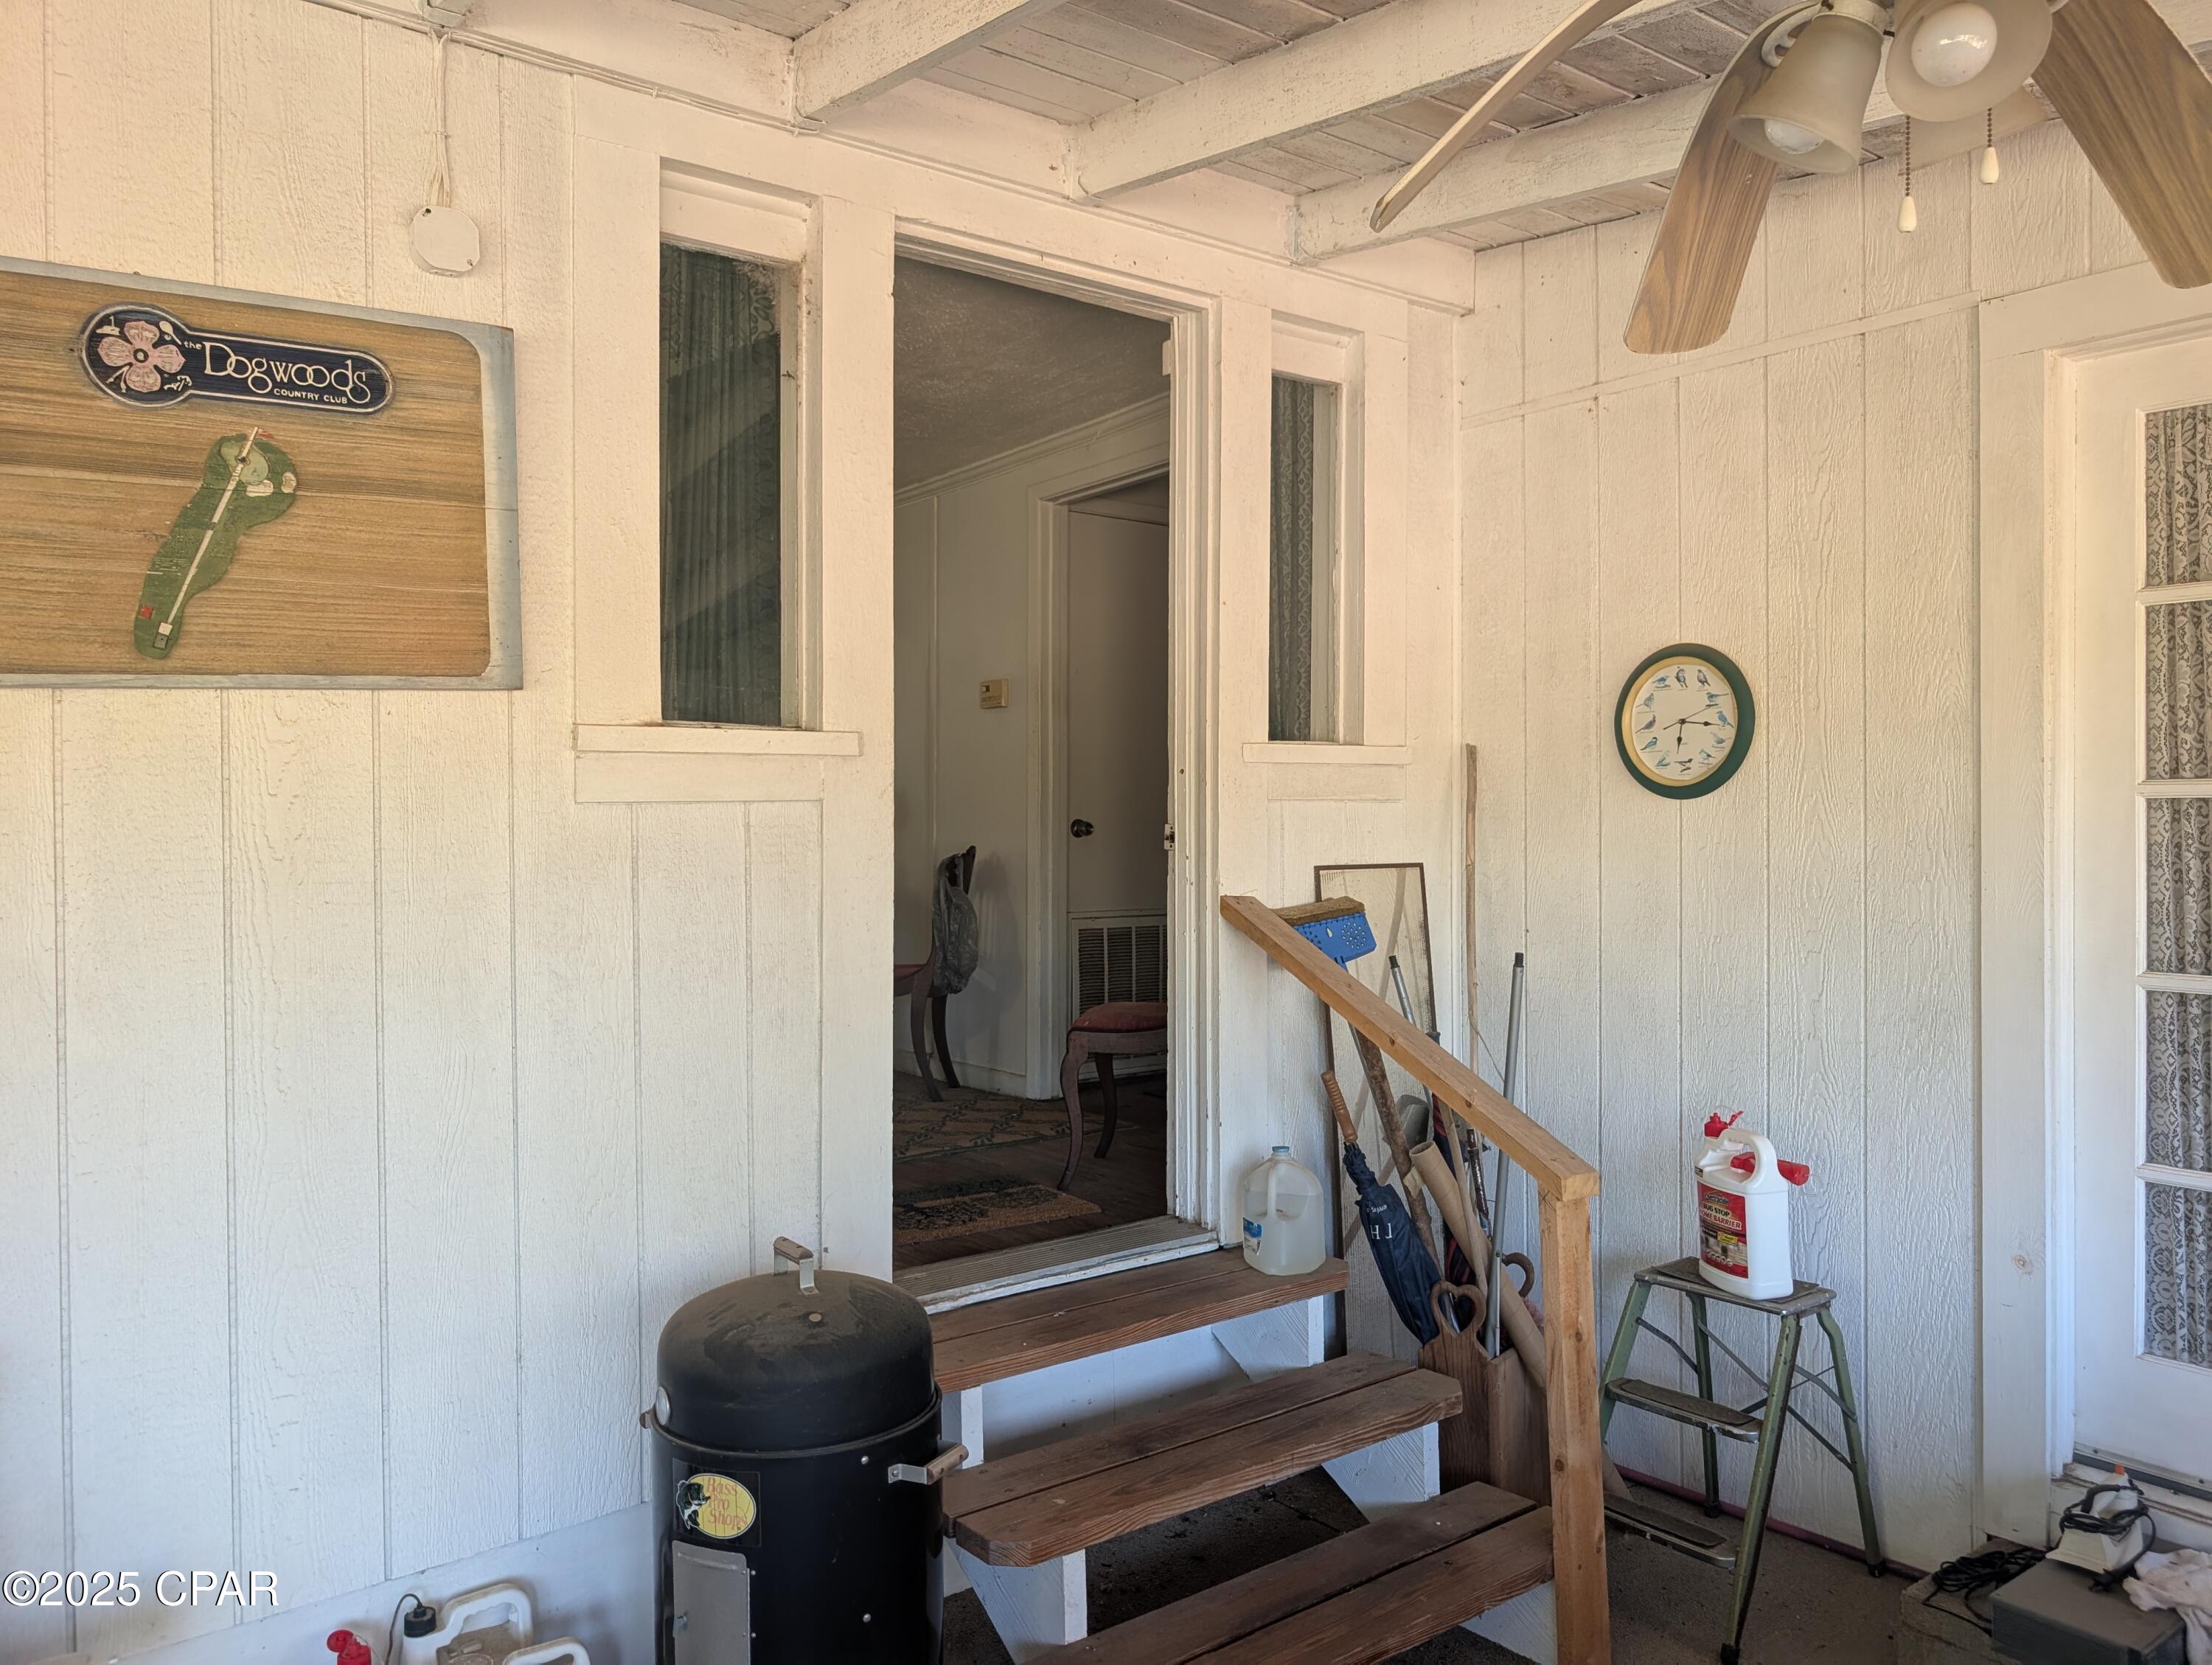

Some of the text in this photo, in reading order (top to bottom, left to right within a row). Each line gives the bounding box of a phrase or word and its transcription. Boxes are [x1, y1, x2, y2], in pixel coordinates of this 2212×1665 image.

[184, 341, 370, 404] the Dogwoods
[274, 387, 347, 404] COUNTRY CLUB
[1714, 1207, 1730, 1217] STOP
[1714, 1214, 1741, 1228] BARRIER
[707, 1477, 738, 1496] Bass
[709, 1493, 730, 1510] Pro
[708, 1509, 748, 1530] Shops
